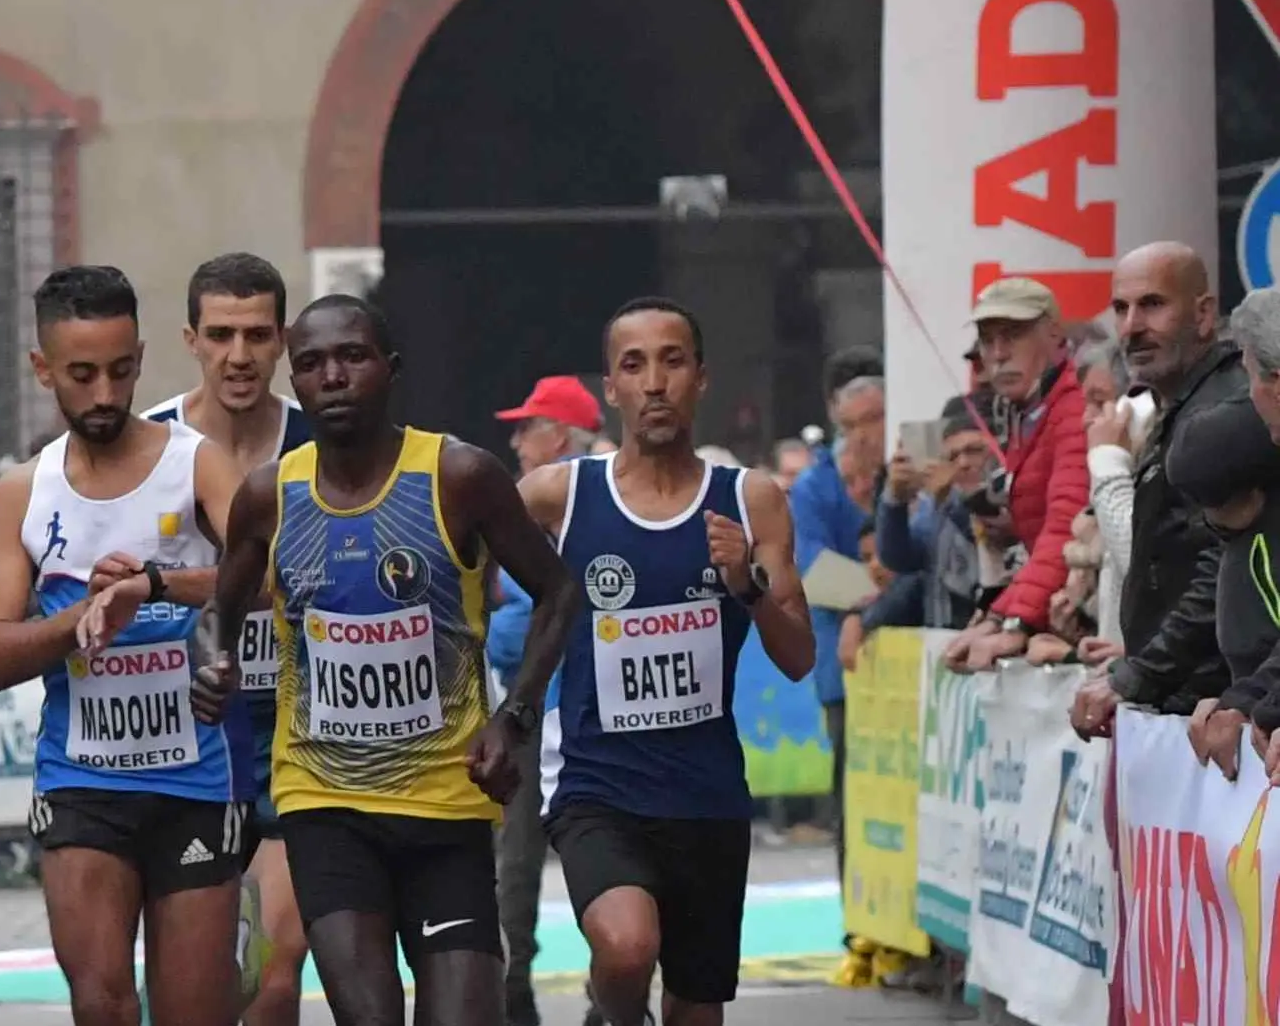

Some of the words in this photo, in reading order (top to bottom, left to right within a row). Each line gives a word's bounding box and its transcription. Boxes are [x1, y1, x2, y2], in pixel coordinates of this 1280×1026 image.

[328, 615, 430, 644] CONAD
[624, 608, 718, 637] CONAD
[90, 649, 186, 677] CONAD
[621, 651, 701, 701] BATEL
[315, 654, 434, 710] KISORIO
[80, 690, 181, 742] MADOUH
[319, 715, 431, 738] ROVERETO
[613, 703, 713, 729] ROVERETO
[78, 747, 187, 769] ROVERETO
